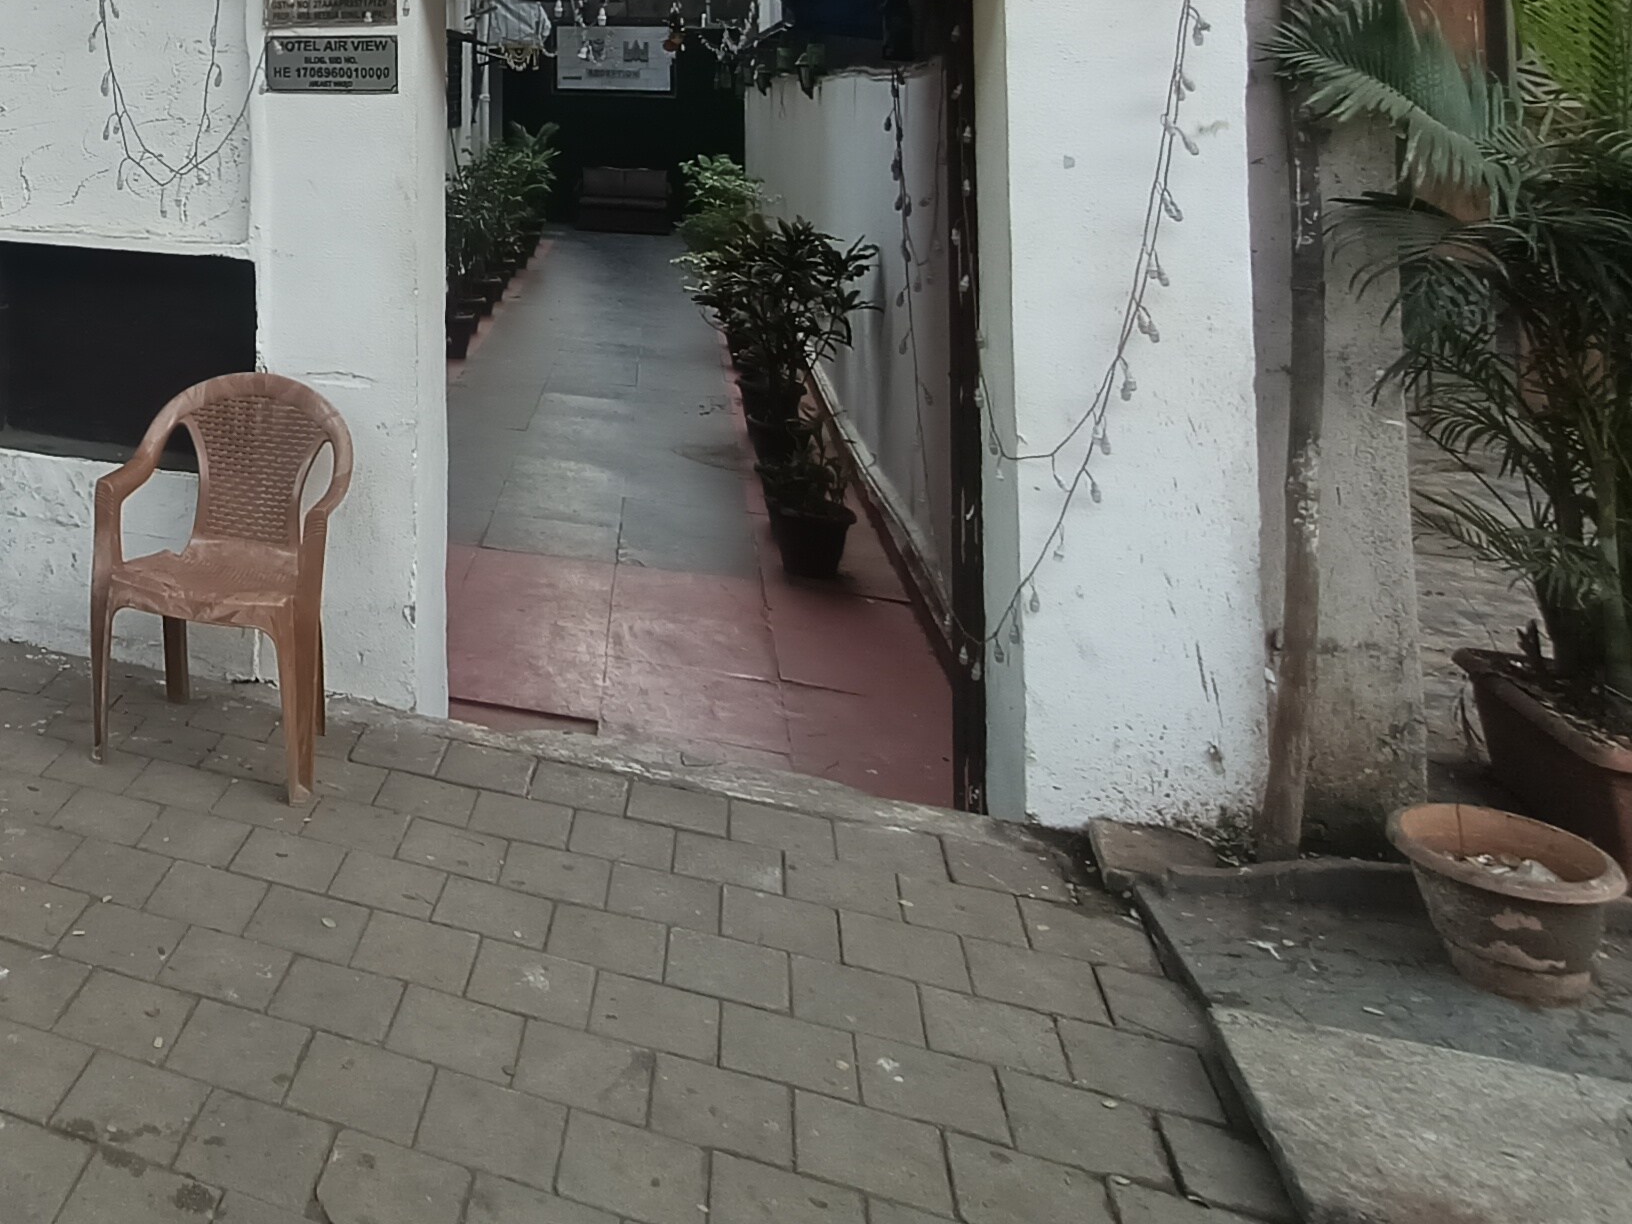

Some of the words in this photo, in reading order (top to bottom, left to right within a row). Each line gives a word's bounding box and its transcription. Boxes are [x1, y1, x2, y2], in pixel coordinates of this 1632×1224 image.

[324, 40, 348, 52] AIR
[351, 40, 388, 52] VIEW
[273, 66, 291, 79] HE
